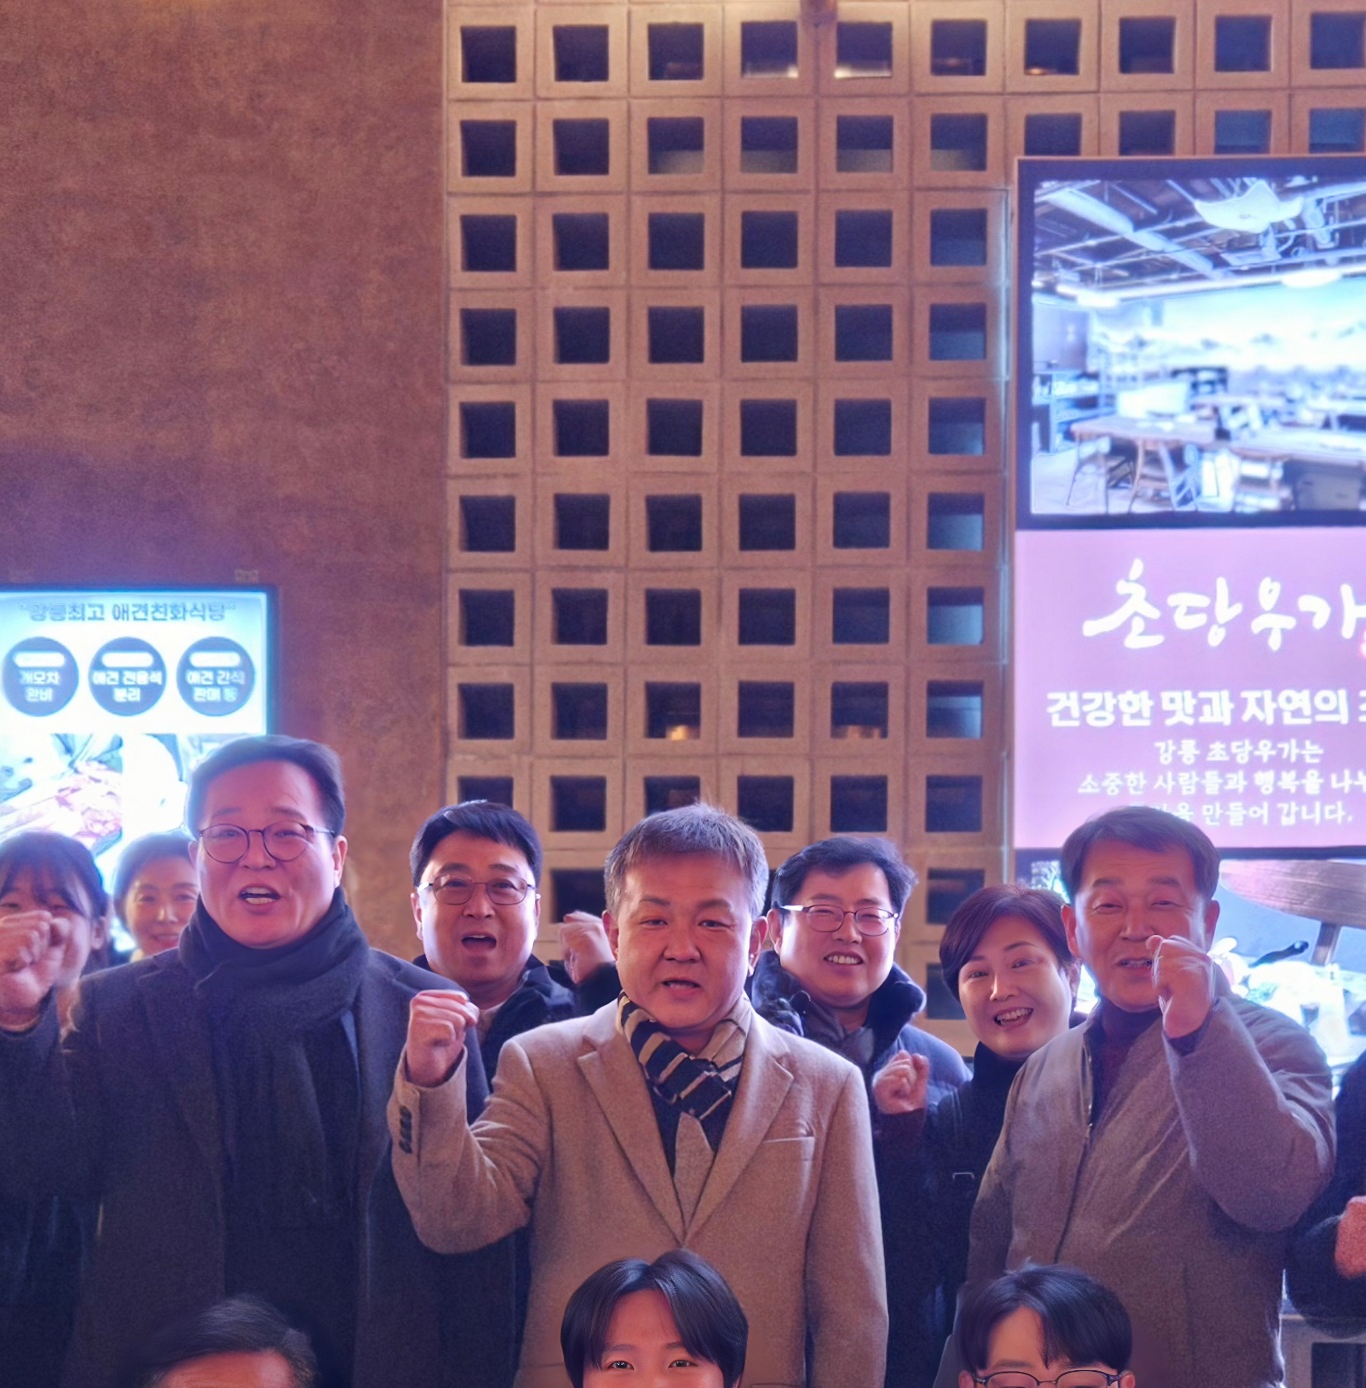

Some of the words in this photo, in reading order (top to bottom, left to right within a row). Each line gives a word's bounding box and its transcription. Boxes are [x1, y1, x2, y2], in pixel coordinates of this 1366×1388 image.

[1046, 690, 1154, 727] 건강한
[1160, 689, 1233, 726] 맛과
[1241, 688, 1349, 725] 자연의
[1154, 739, 1200, 763] 강릉
[1206, 738, 1324, 763] 초당우가는
[1077, 771, 1146, 795] 소중한
[1153, 770, 1246, 795] 사람들과
[1253, 769, 1324, 794] 행복을
[1201, 803, 1269, 826] 만들어
[1277, 801, 1353, 826] 갑니다.
